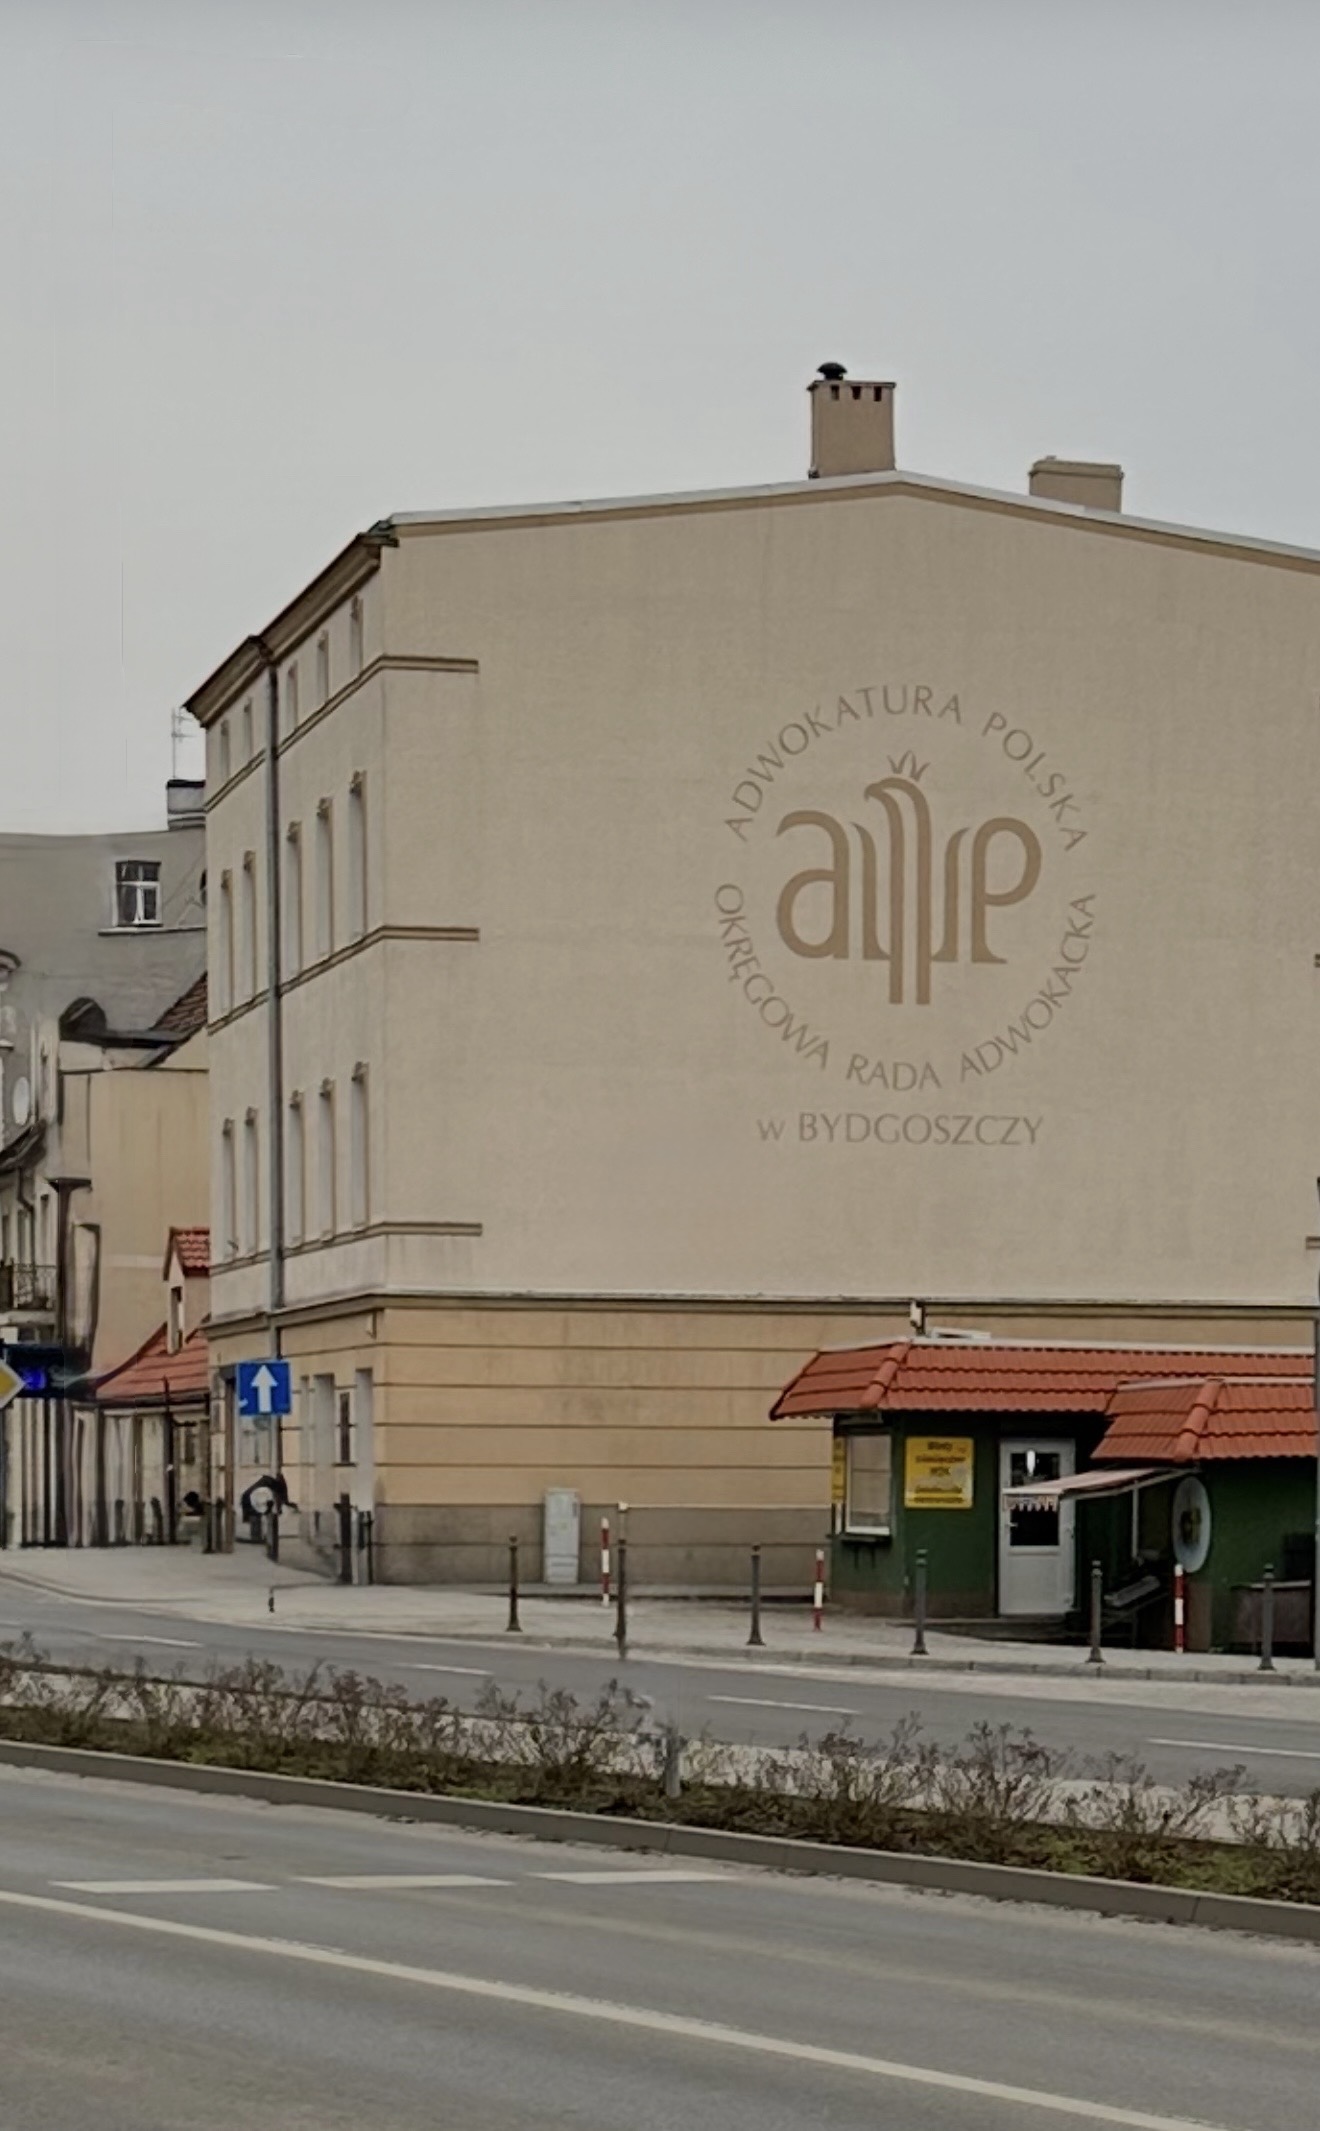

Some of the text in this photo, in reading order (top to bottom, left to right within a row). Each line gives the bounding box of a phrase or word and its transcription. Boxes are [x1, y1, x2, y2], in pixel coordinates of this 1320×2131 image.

[724, 685, 1087, 851] ADWOKATURA POLSKA
[714, 883, 1097, 1091] OKRĘGOWA RADA ADWOKACKA
[798, 1112, 1044, 1146] BYDGOSZCZY
